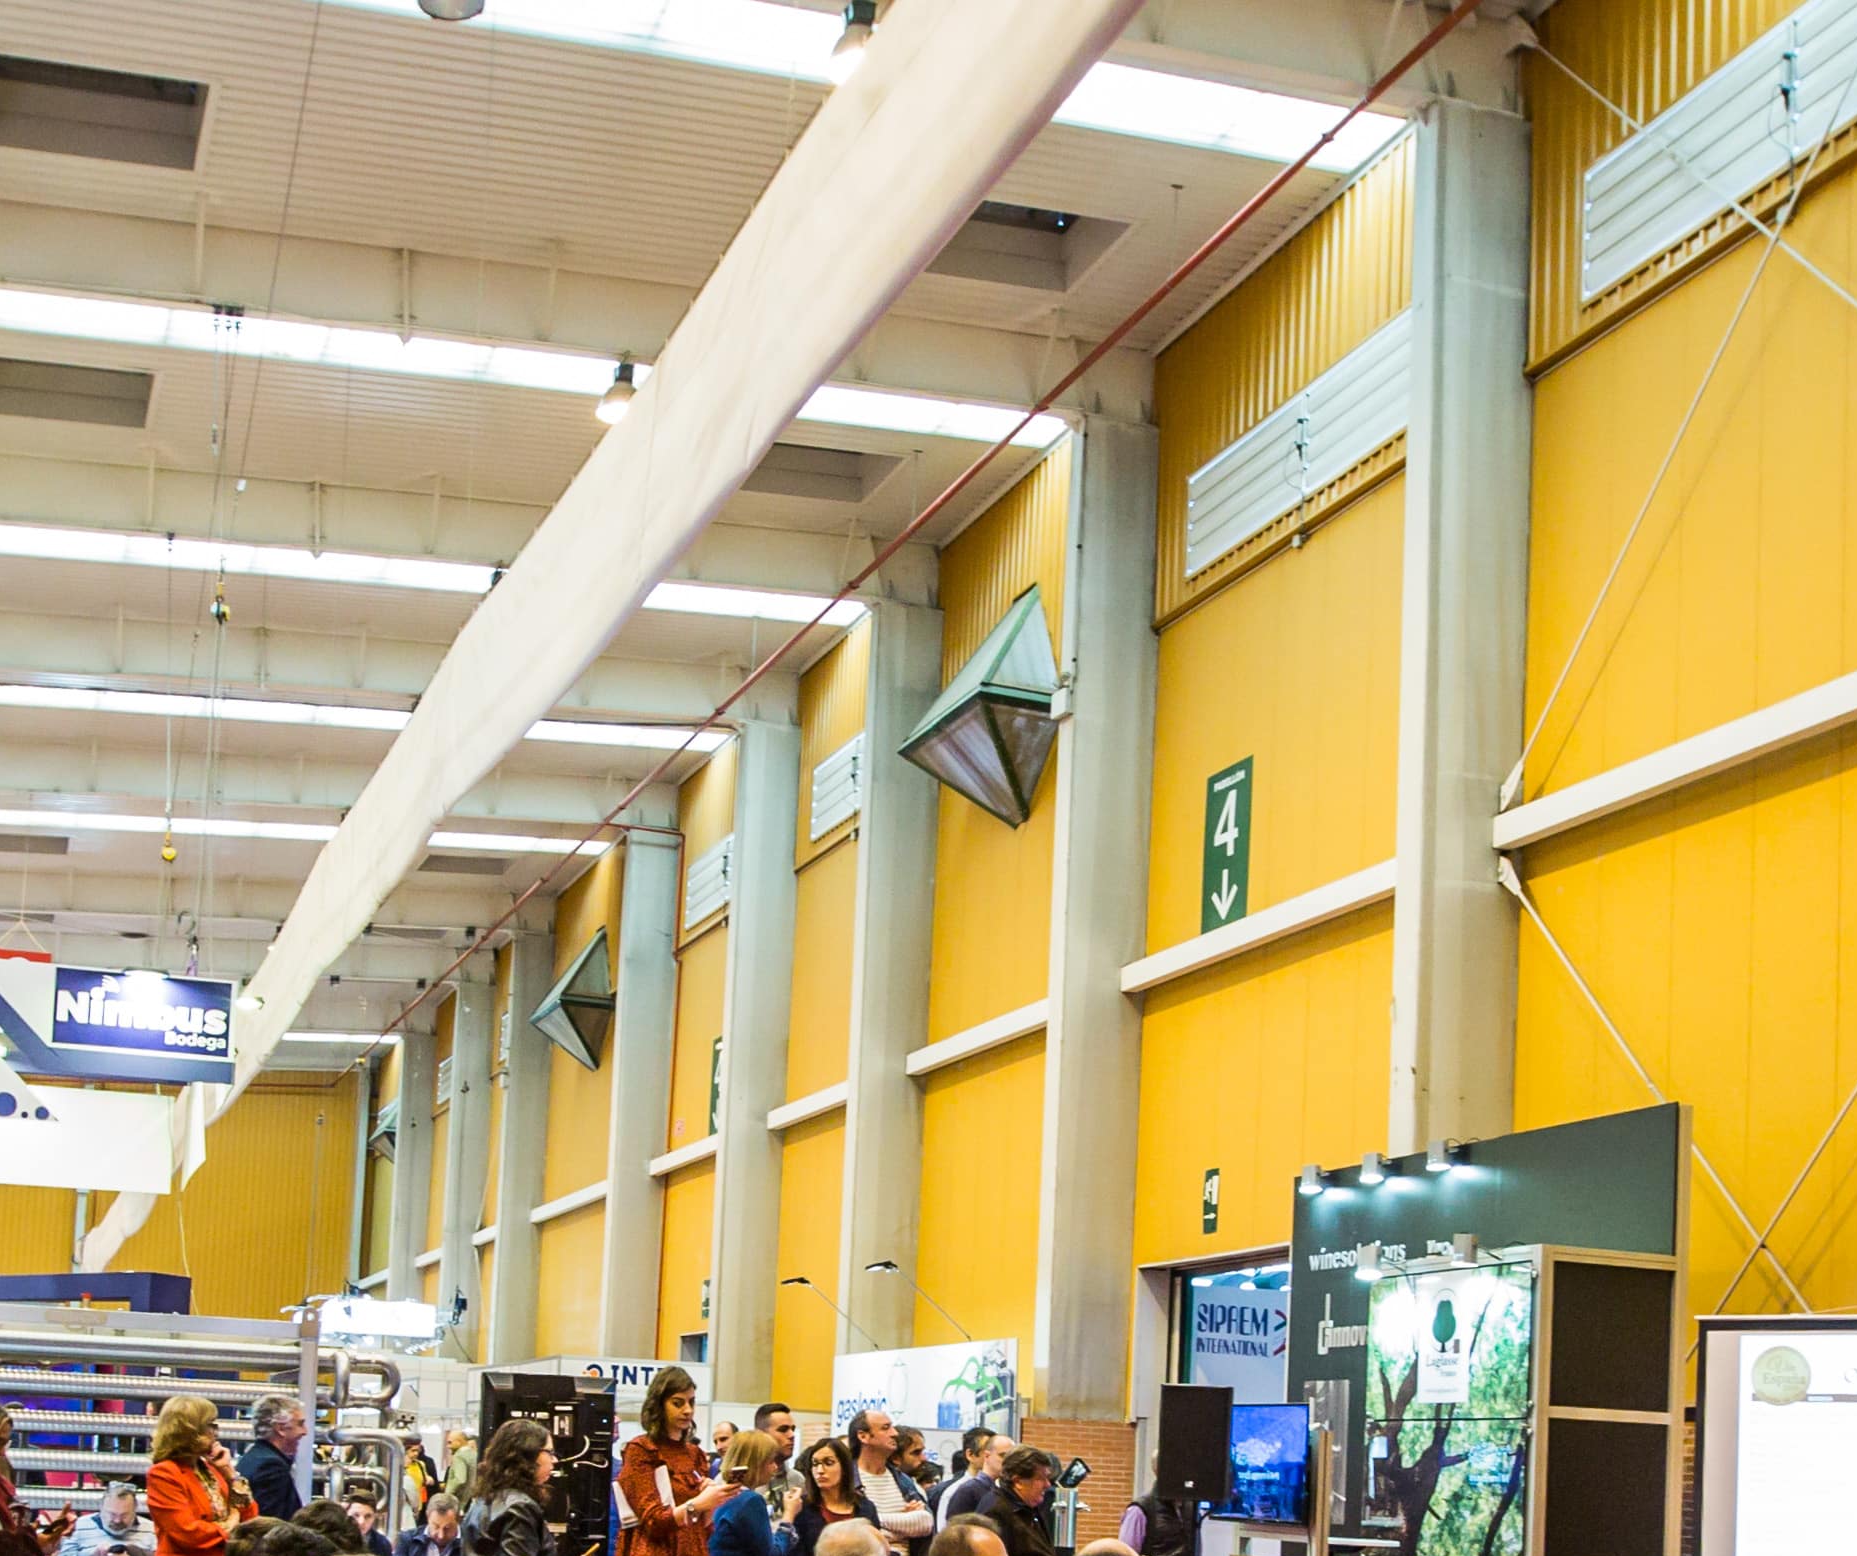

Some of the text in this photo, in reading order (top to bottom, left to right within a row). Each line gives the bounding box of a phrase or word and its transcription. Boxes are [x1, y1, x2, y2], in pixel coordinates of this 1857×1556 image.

[1213, 788, 1239, 857] 4
[55, 986, 228, 1036] Nimbus
[163, 1031, 227, 1052] Bodega
